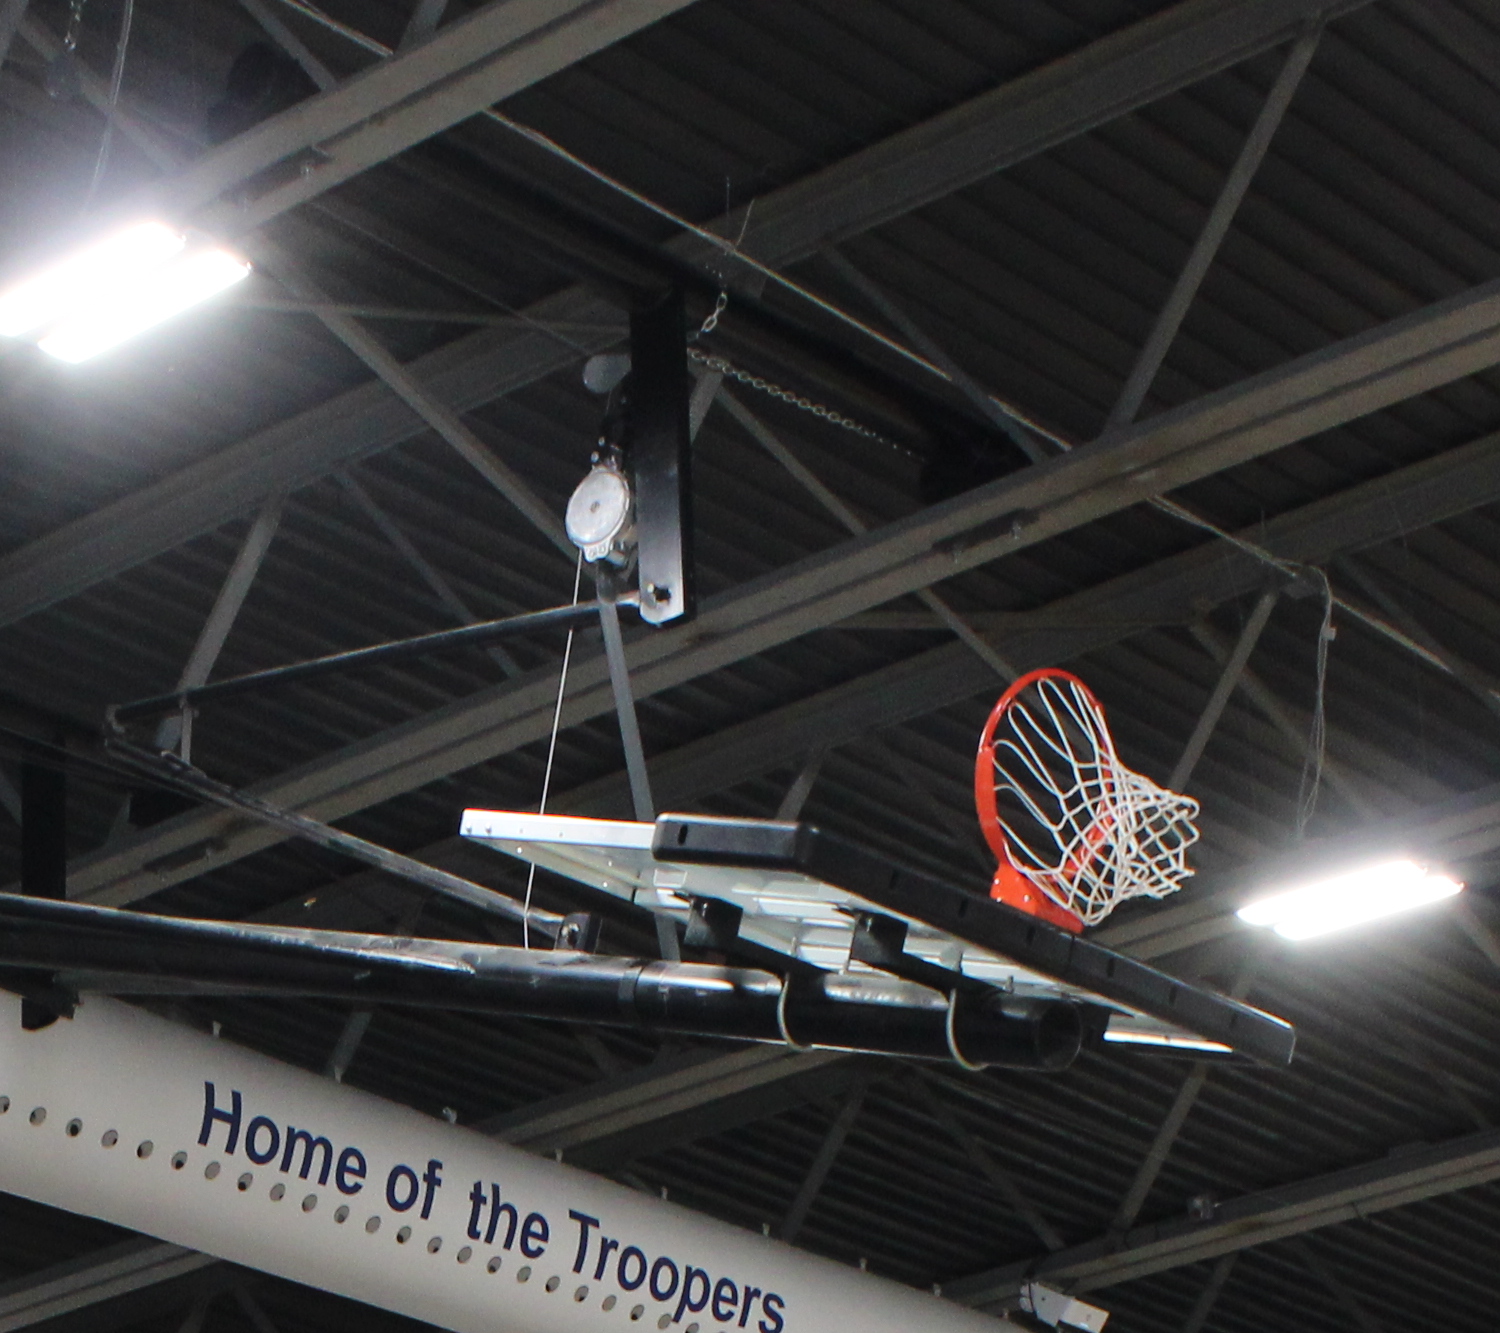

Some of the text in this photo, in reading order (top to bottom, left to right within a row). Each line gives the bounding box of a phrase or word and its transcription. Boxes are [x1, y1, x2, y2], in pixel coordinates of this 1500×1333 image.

[197, 1081, 368, 1194] Home
[385, 1158, 444, 1219] of
[468, 1180, 550, 1258] the
